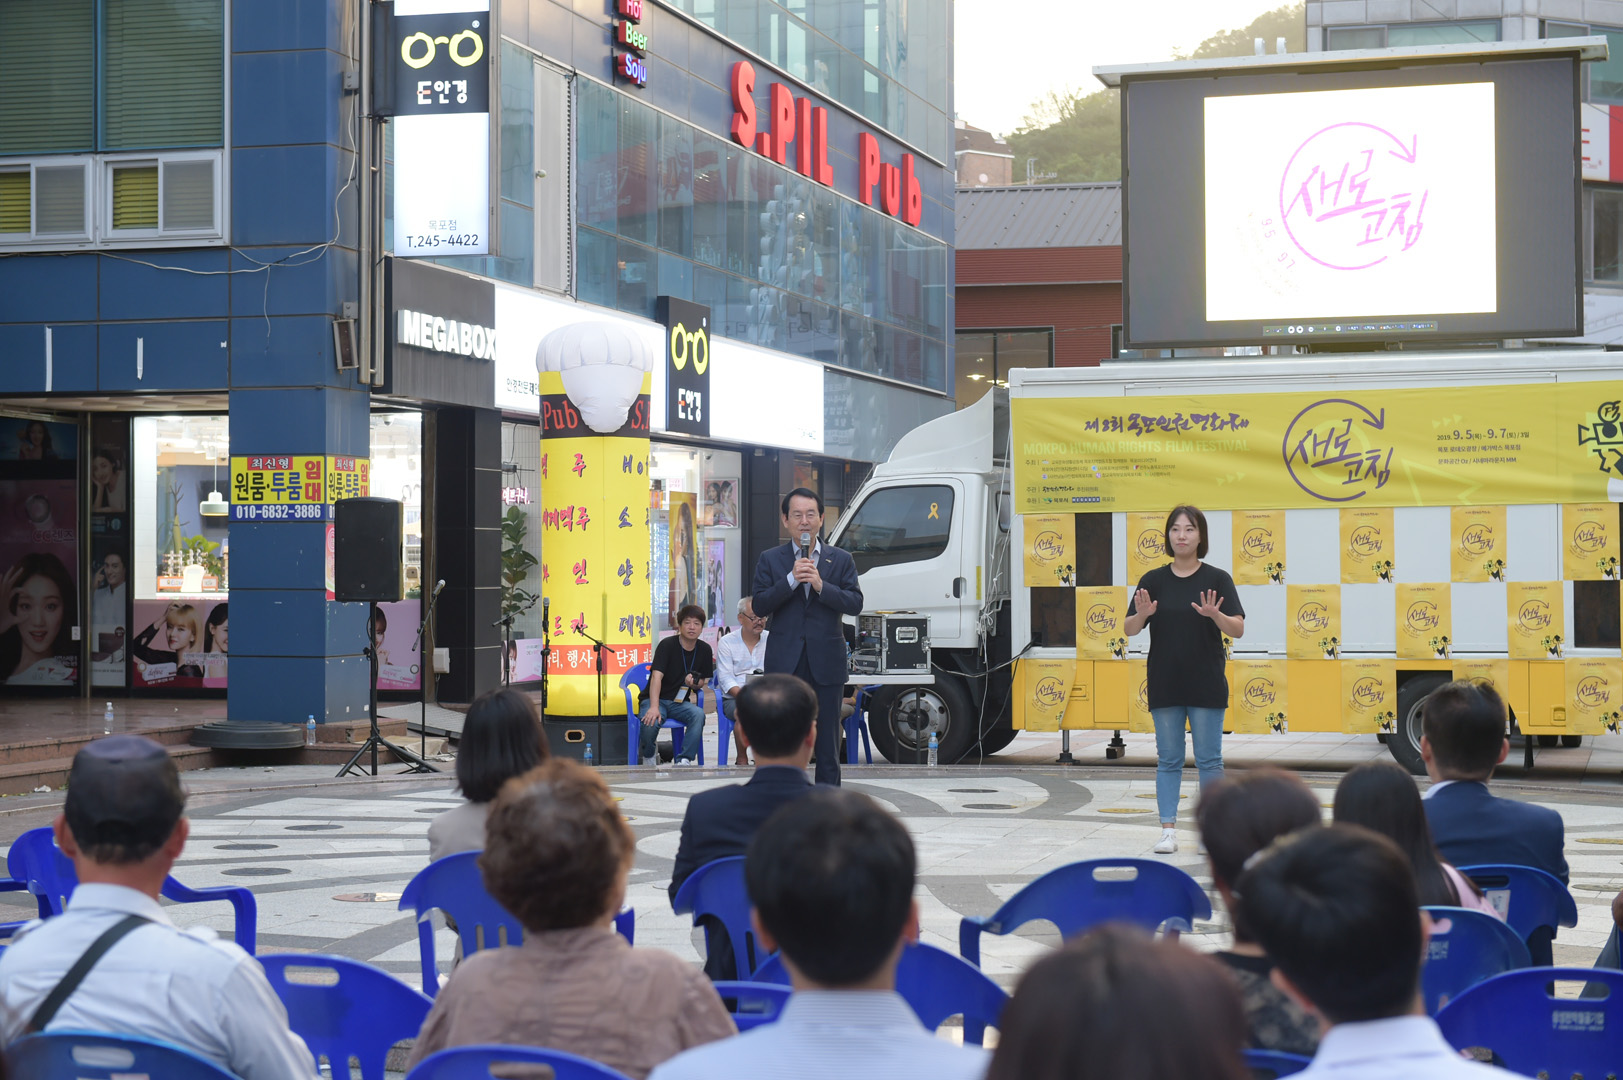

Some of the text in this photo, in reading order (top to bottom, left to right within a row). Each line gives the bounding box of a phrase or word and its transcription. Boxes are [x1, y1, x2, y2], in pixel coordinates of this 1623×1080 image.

[625, 21, 648, 50] Beer
[625, 53, 647, 84] Soju
[731, 60, 922, 227] S.PIL Pub
[1284, 149, 1386, 222] 새로
[429, 219, 457, 231] 목포점
[1356, 189, 1429, 252] 고침
[406, 234, 479, 248] T.245-4422
[398, 309, 497, 361] MEGABOX
[543, 400, 578, 430] Pub
[1023, 439, 1250, 455] MOKPO HUMAN RIGHTS FILM FESTIVAL
[1287, 418, 1362, 468] 새로
[250, 458, 290, 470] 최신형
[335, 459, 356, 472] 최신형
[1341, 447, 1394, 489] 고침
[236, 504, 321, 519] 010-6832-3886
[567, 649, 594, 669] 행사
[616, 648, 638, 668] 단체
